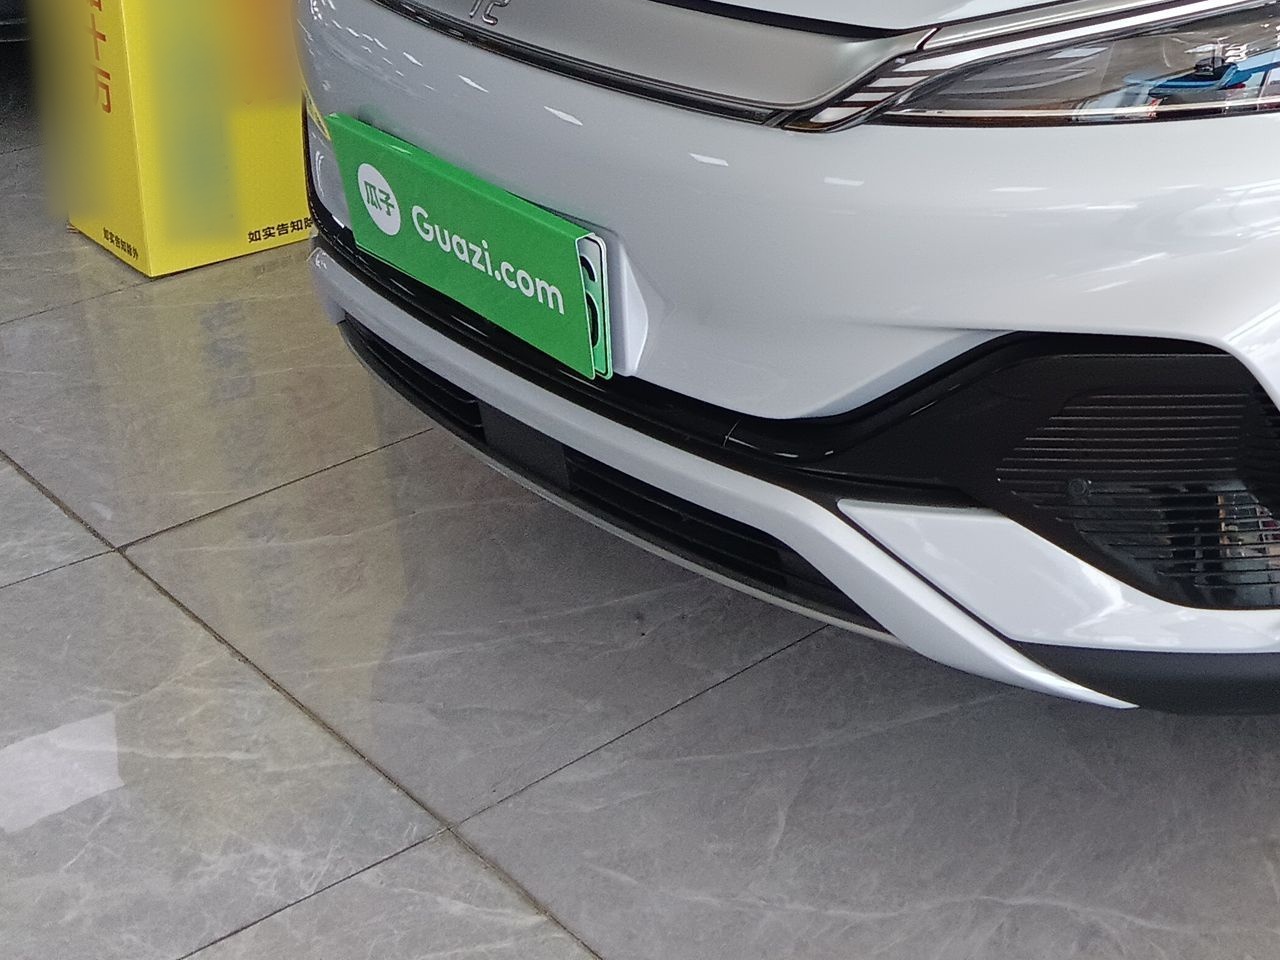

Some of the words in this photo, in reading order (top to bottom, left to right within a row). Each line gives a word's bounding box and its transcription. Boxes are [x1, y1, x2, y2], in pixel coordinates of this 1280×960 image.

[363, 179, 394, 217] 瓜子
[103, 226, 139, 260] 如实告知除外
[411, 204, 565, 315] Guazi.com
